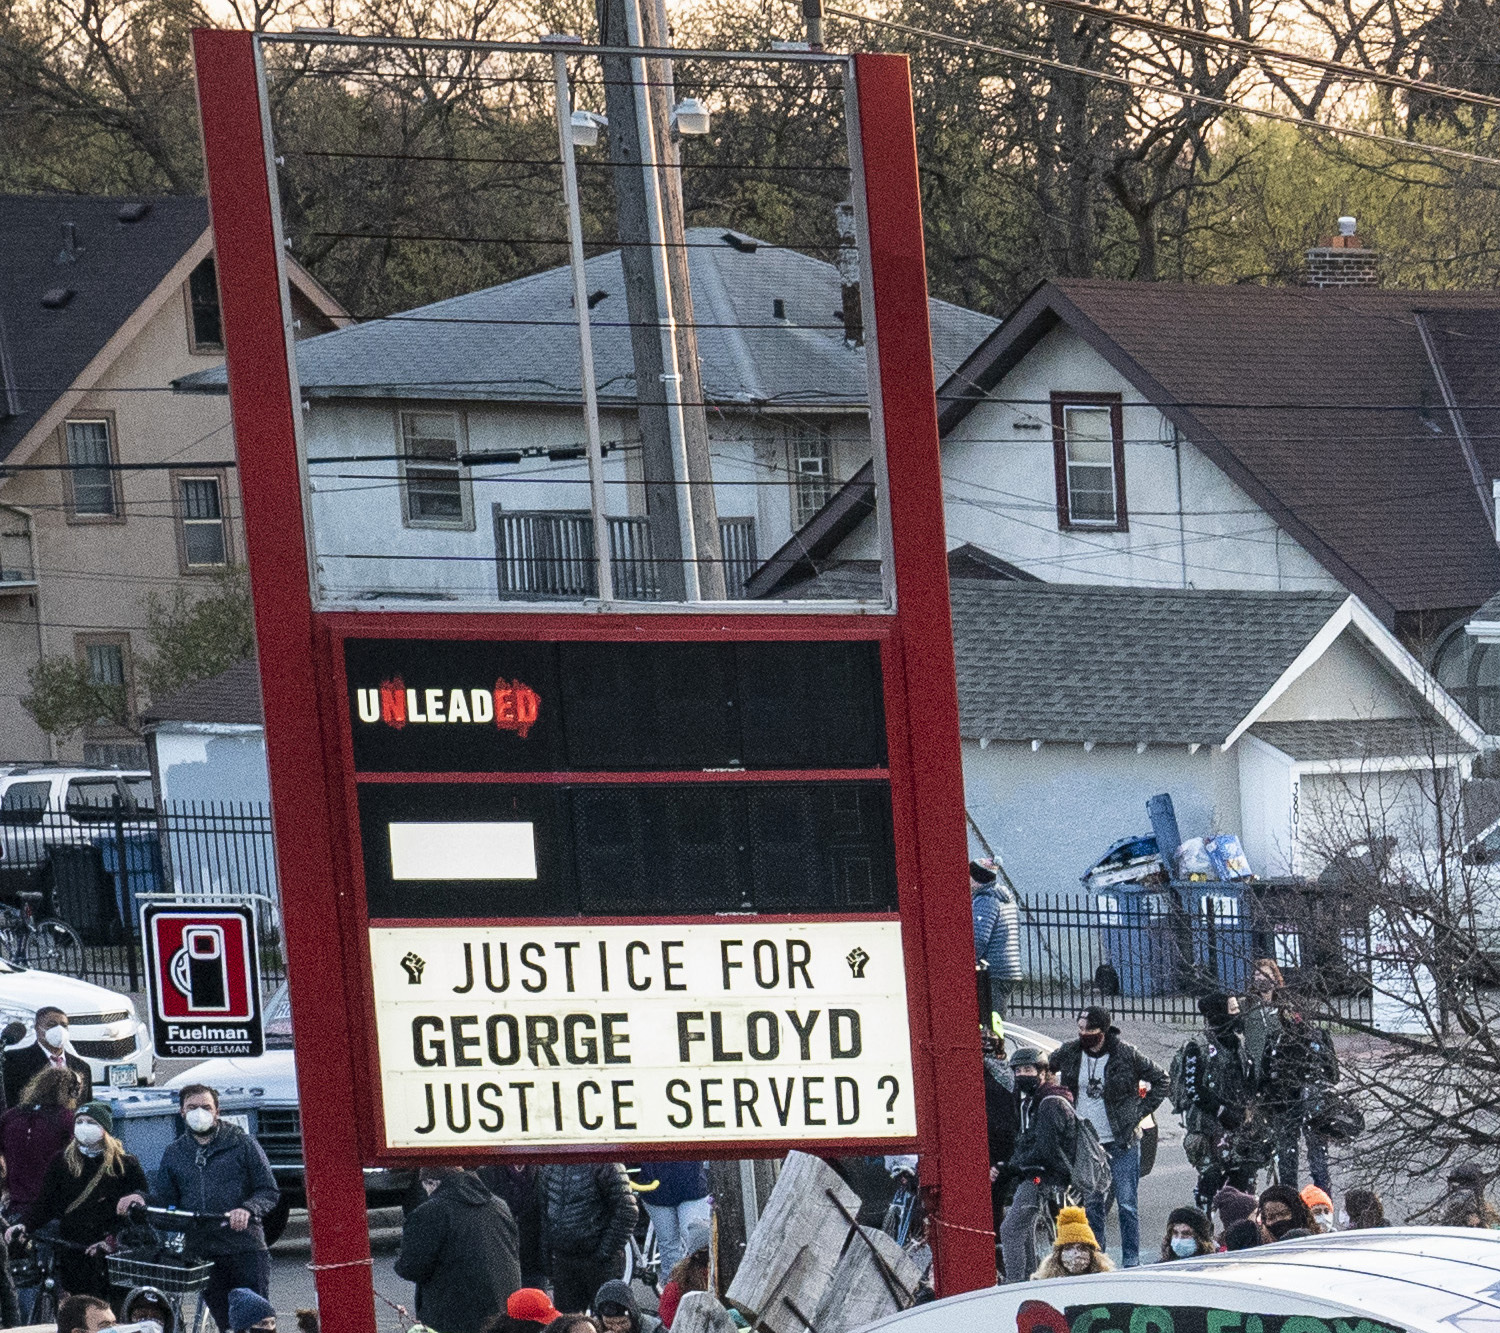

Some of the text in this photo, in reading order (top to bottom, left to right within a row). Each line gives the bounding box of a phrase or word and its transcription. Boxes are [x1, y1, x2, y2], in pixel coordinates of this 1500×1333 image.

[454, 938, 814, 994] JUSTICE FOR
[166, 1023, 249, 1042] Fuelman
[168, 1044, 250, 1057] 1-800-FUELMAN
[411, 1008, 862, 1068] GEORGE FLOYD
[415, 1079, 637, 1134] JUSTICE
